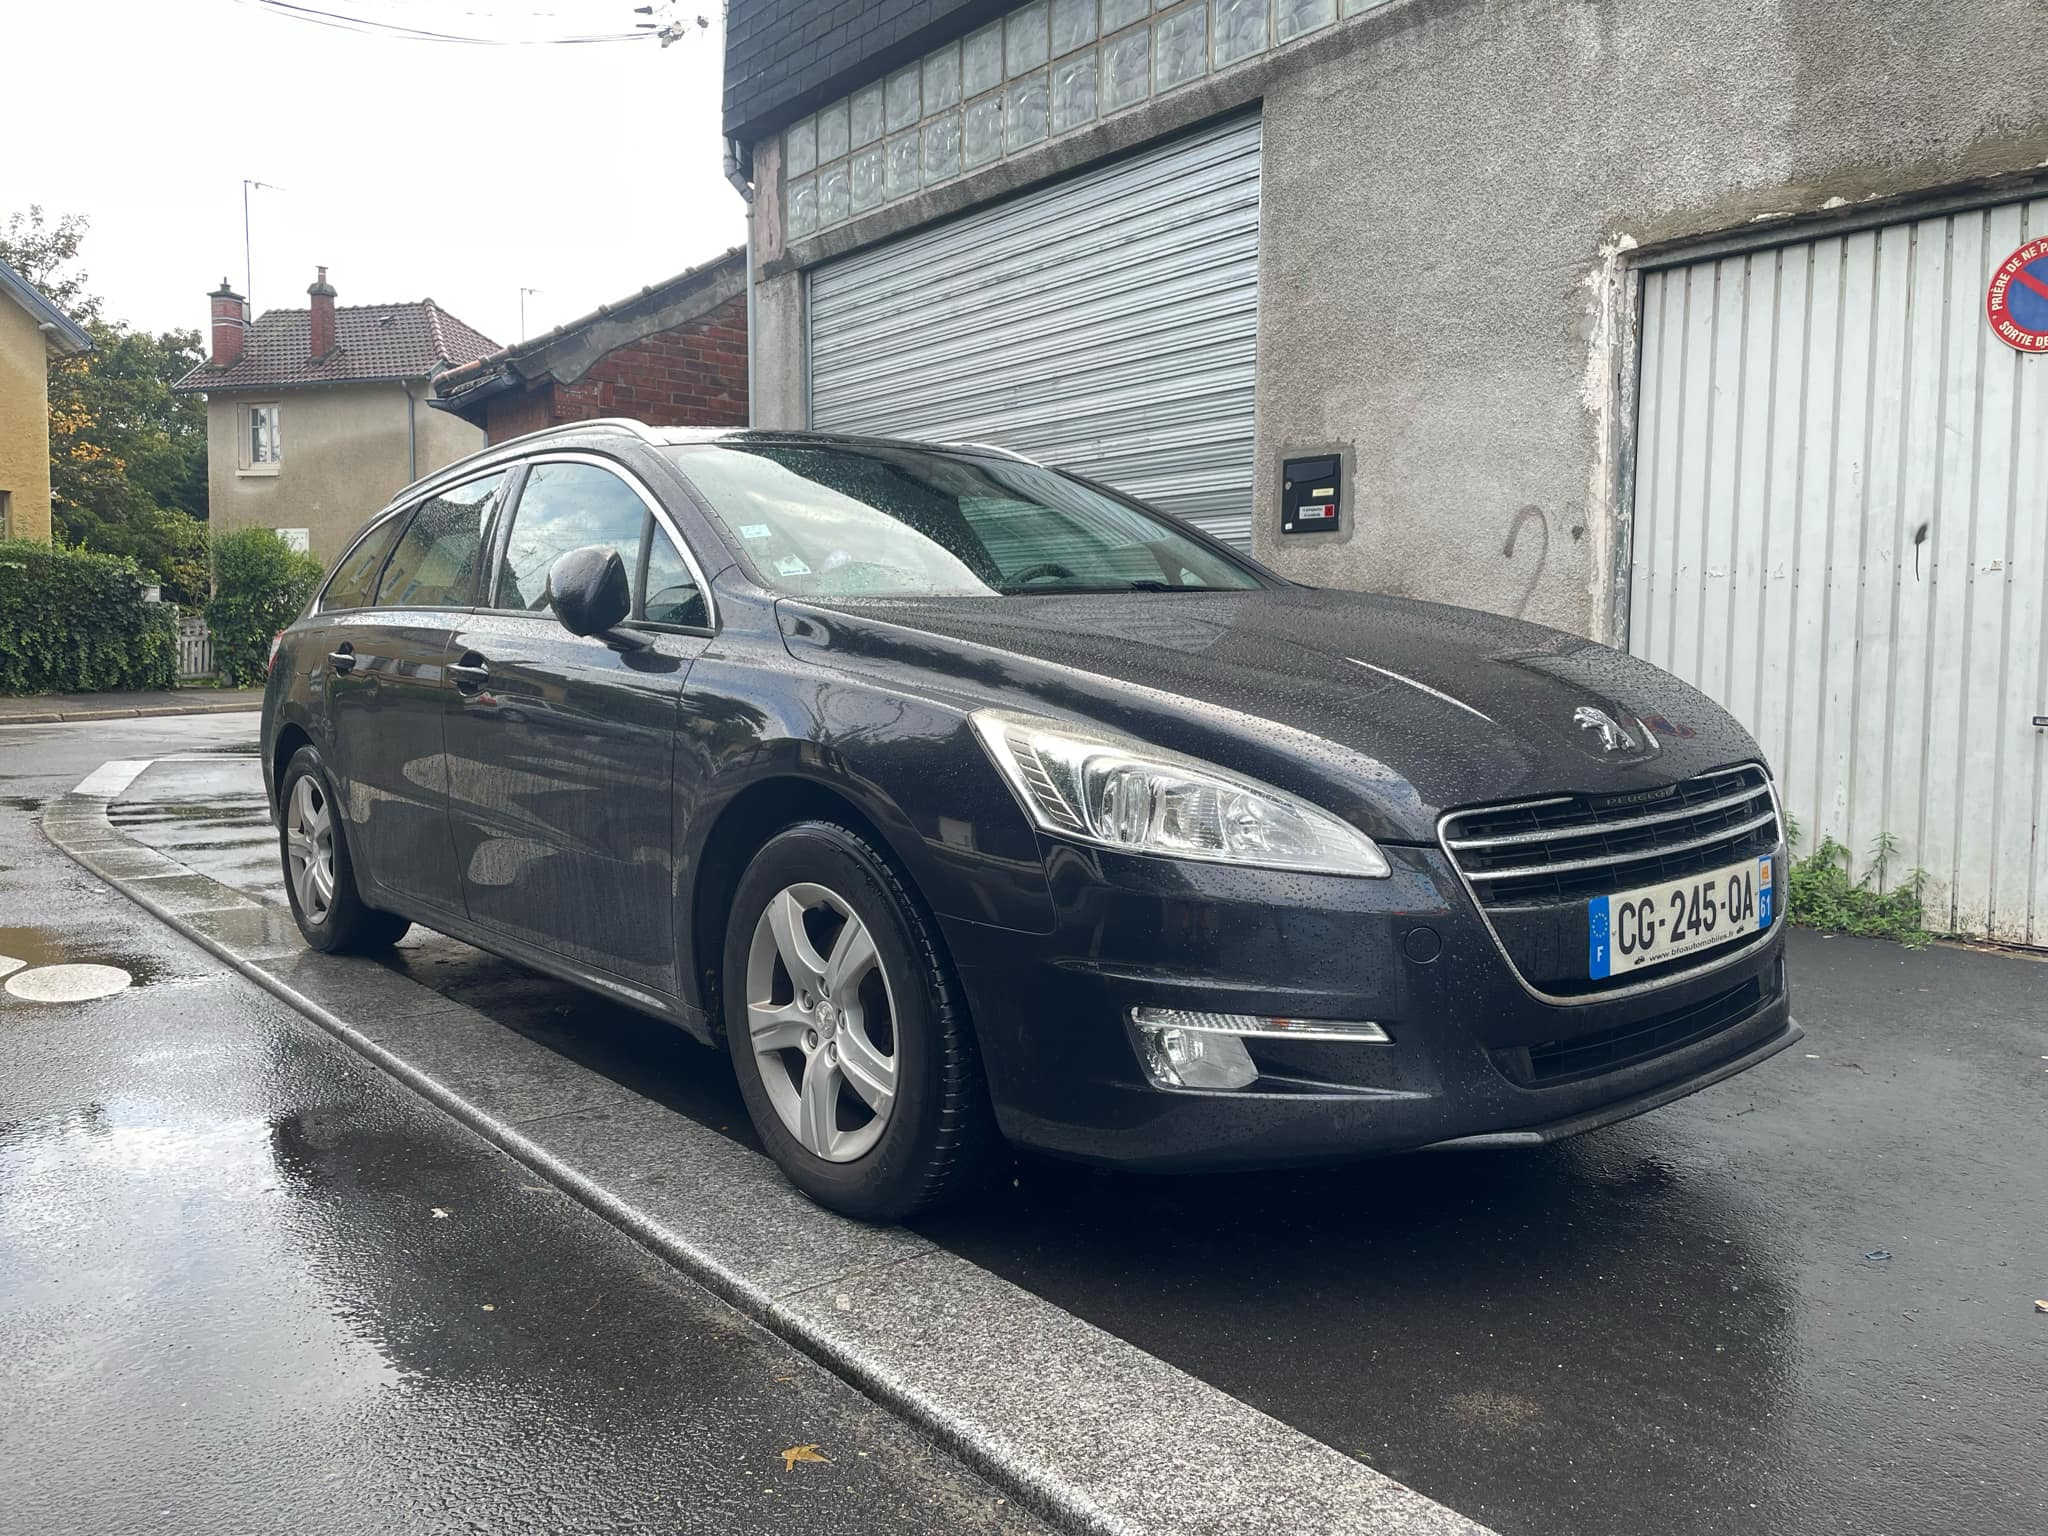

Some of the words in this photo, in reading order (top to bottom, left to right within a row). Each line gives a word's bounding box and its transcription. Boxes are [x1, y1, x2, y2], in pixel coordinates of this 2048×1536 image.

[1991, 272, 2010, 311] PRIÈRE
[2005, 257, 2022, 273] DE
[2021, 246, 2038, 261] NE
[2040, 242, 2048, 254] P
[1999, 321, 2034, 346] SORTIE
[1618, 870, 1754, 955] CG-245-QA
[1760, 893, 1771, 918] 61
[1596, 946, 1604, 962] F
